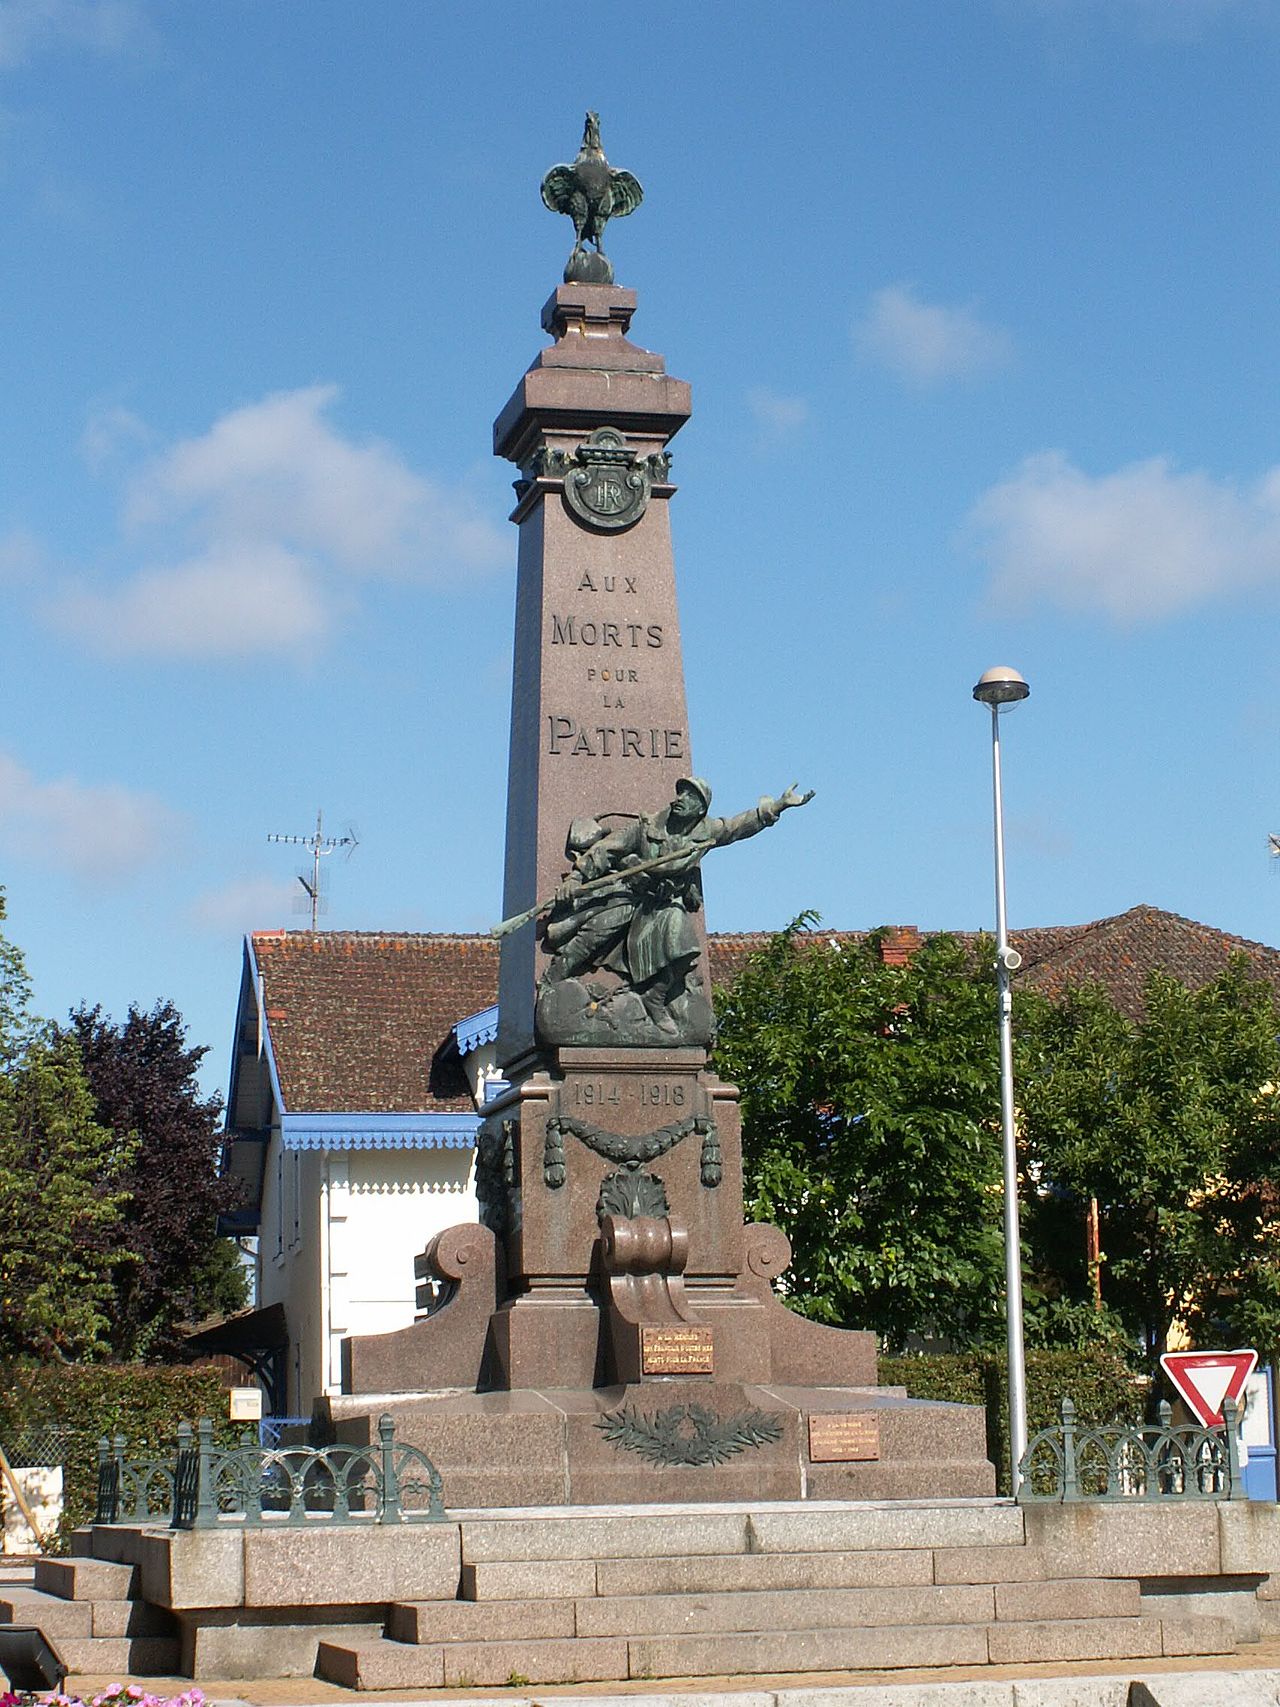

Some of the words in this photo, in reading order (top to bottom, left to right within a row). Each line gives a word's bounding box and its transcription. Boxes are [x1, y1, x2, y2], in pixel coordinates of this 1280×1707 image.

[577, 570, 637, 593] AUX
[551, 615, 663, 648] MORTS
[587, 669, 638, 682] POUR
[603, 695, 625, 709] LA
[548, 716, 684, 758] PATRIE
[641, 1084, 684, 1106] 1918
